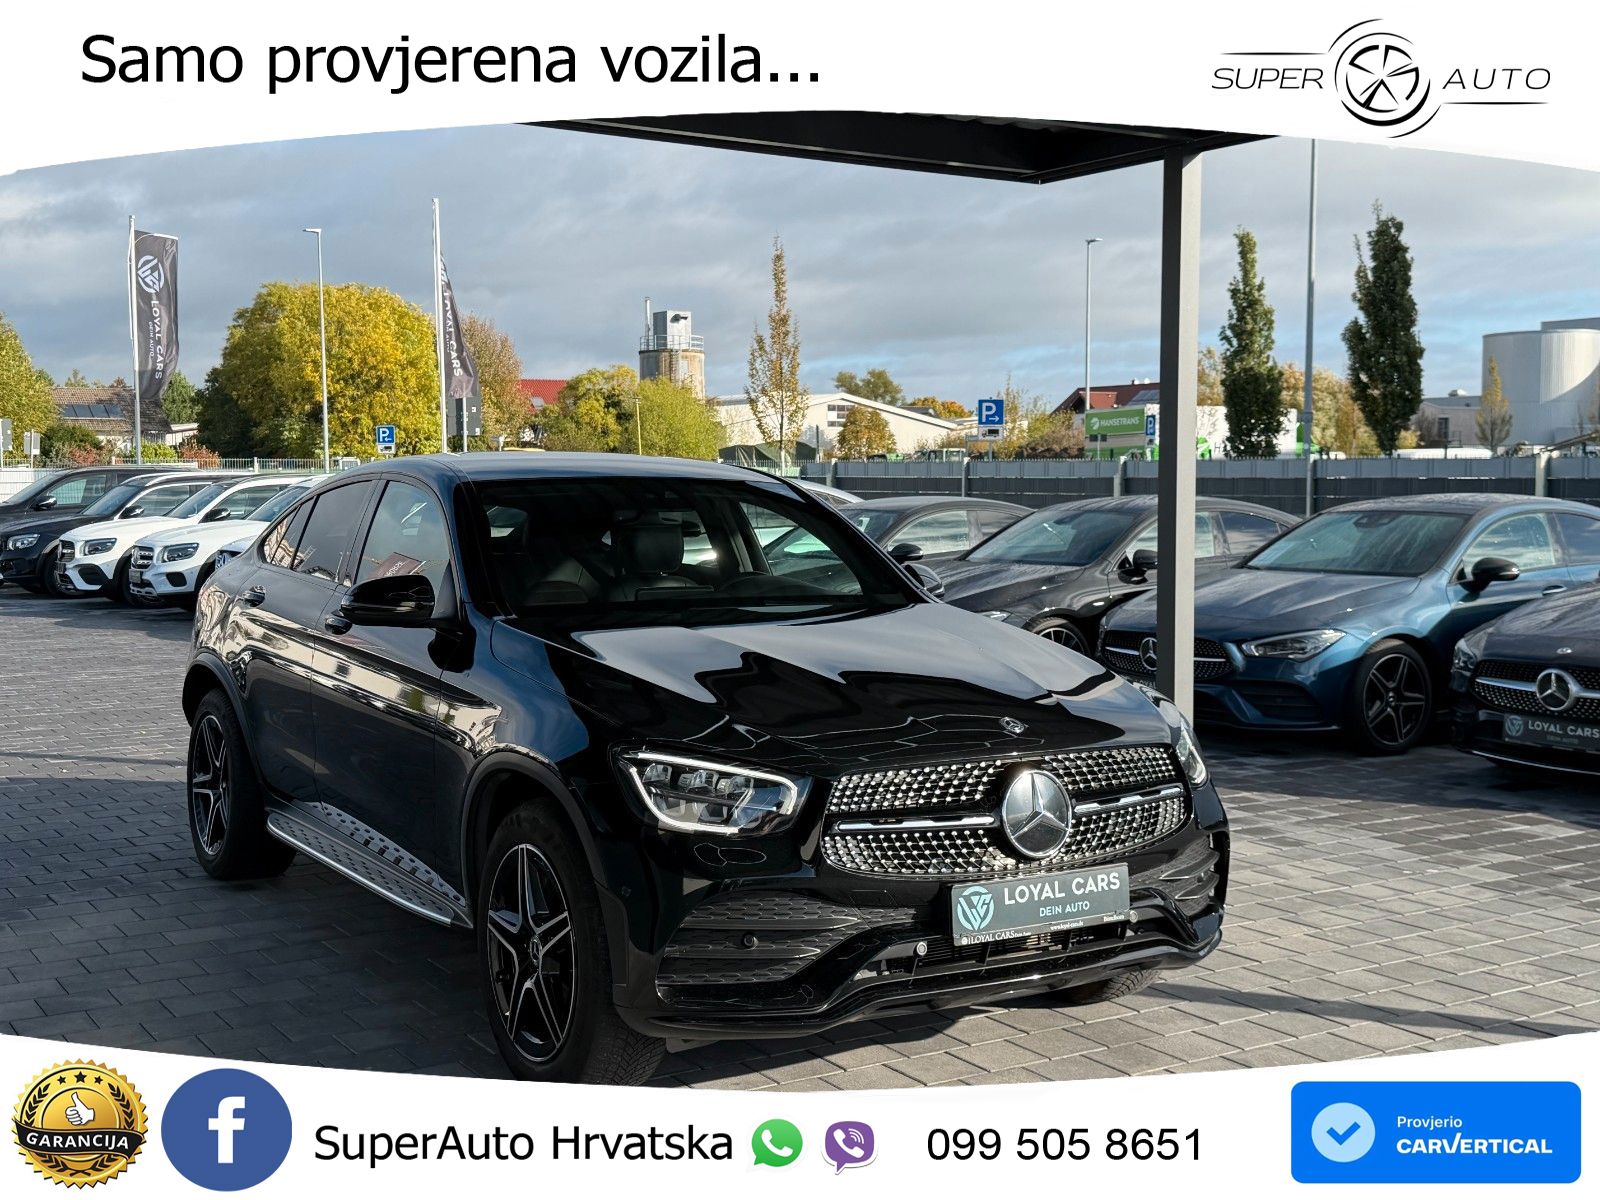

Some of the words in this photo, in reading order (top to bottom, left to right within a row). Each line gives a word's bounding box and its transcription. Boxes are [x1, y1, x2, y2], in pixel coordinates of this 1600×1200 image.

[151, 300, 162, 340] LOYAL
[155, 345, 164, 379] CARS
[450, 340, 463, 377] CARS
[982, 403, 996, 423] P
[1100, 416, 1140, 427] HANSETRANS
[379, 428, 389, 443] P
[1528, 720, 1563, 734] LOYAL
[1567, 726, 1600, 739] CARS
[1003, 881, 1066, 905] LOYAL
[1071, 872, 1121, 895] CARS
[1039, 905, 1062, 917] DEIN
[1065, 901, 1090, 914] AUTO
[971, 933, 995, 944] LOYAL
[995, 930, 1015, 941] CARS
